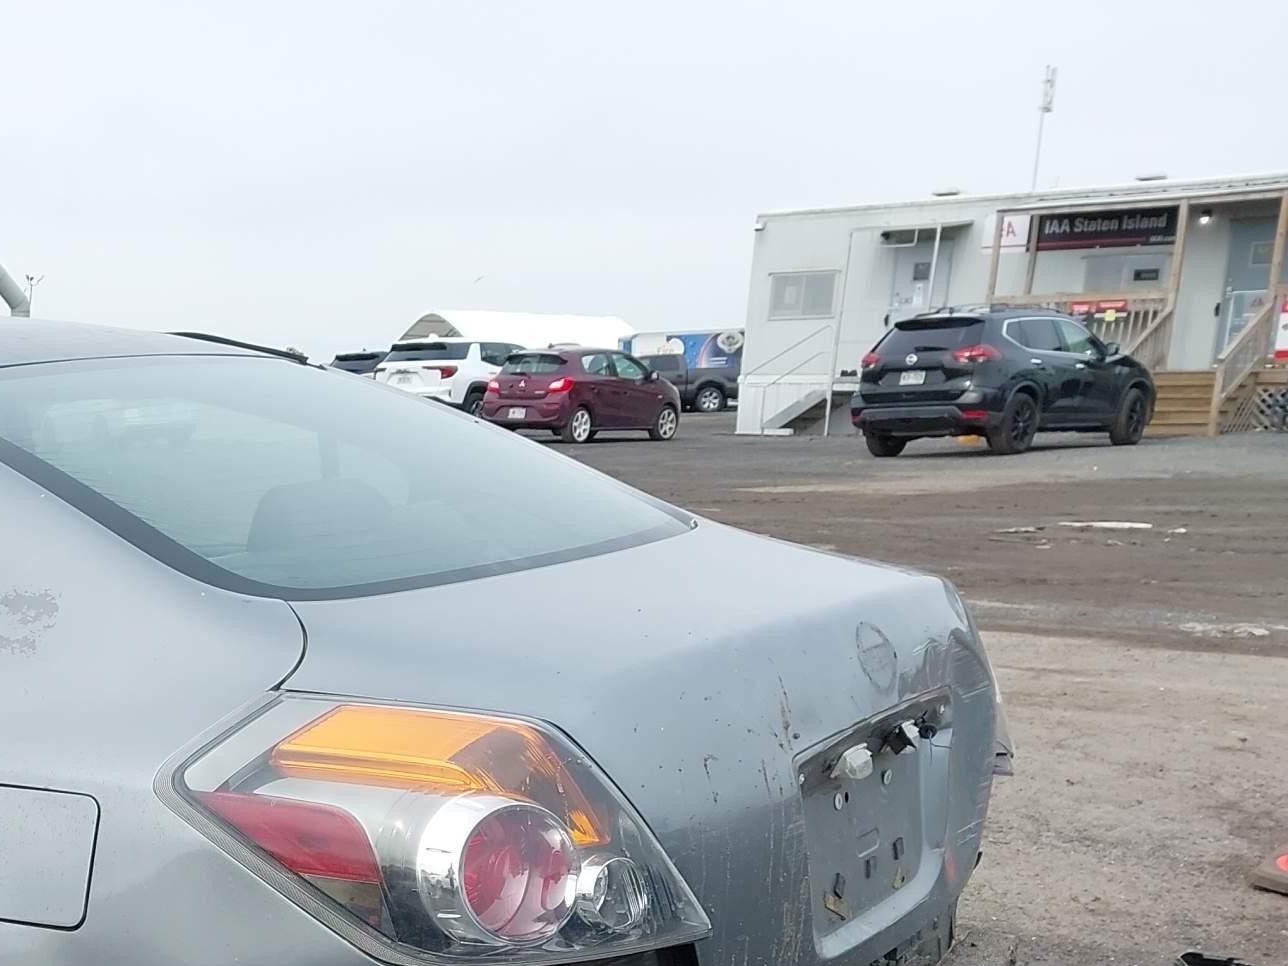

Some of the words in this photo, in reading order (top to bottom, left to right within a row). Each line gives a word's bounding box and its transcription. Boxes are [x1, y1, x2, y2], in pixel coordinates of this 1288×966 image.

[1045, 218, 1070, 234] IAA
[1073, 216, 1119, 233] Staten
[1122, 212, 1168, 230] Island
